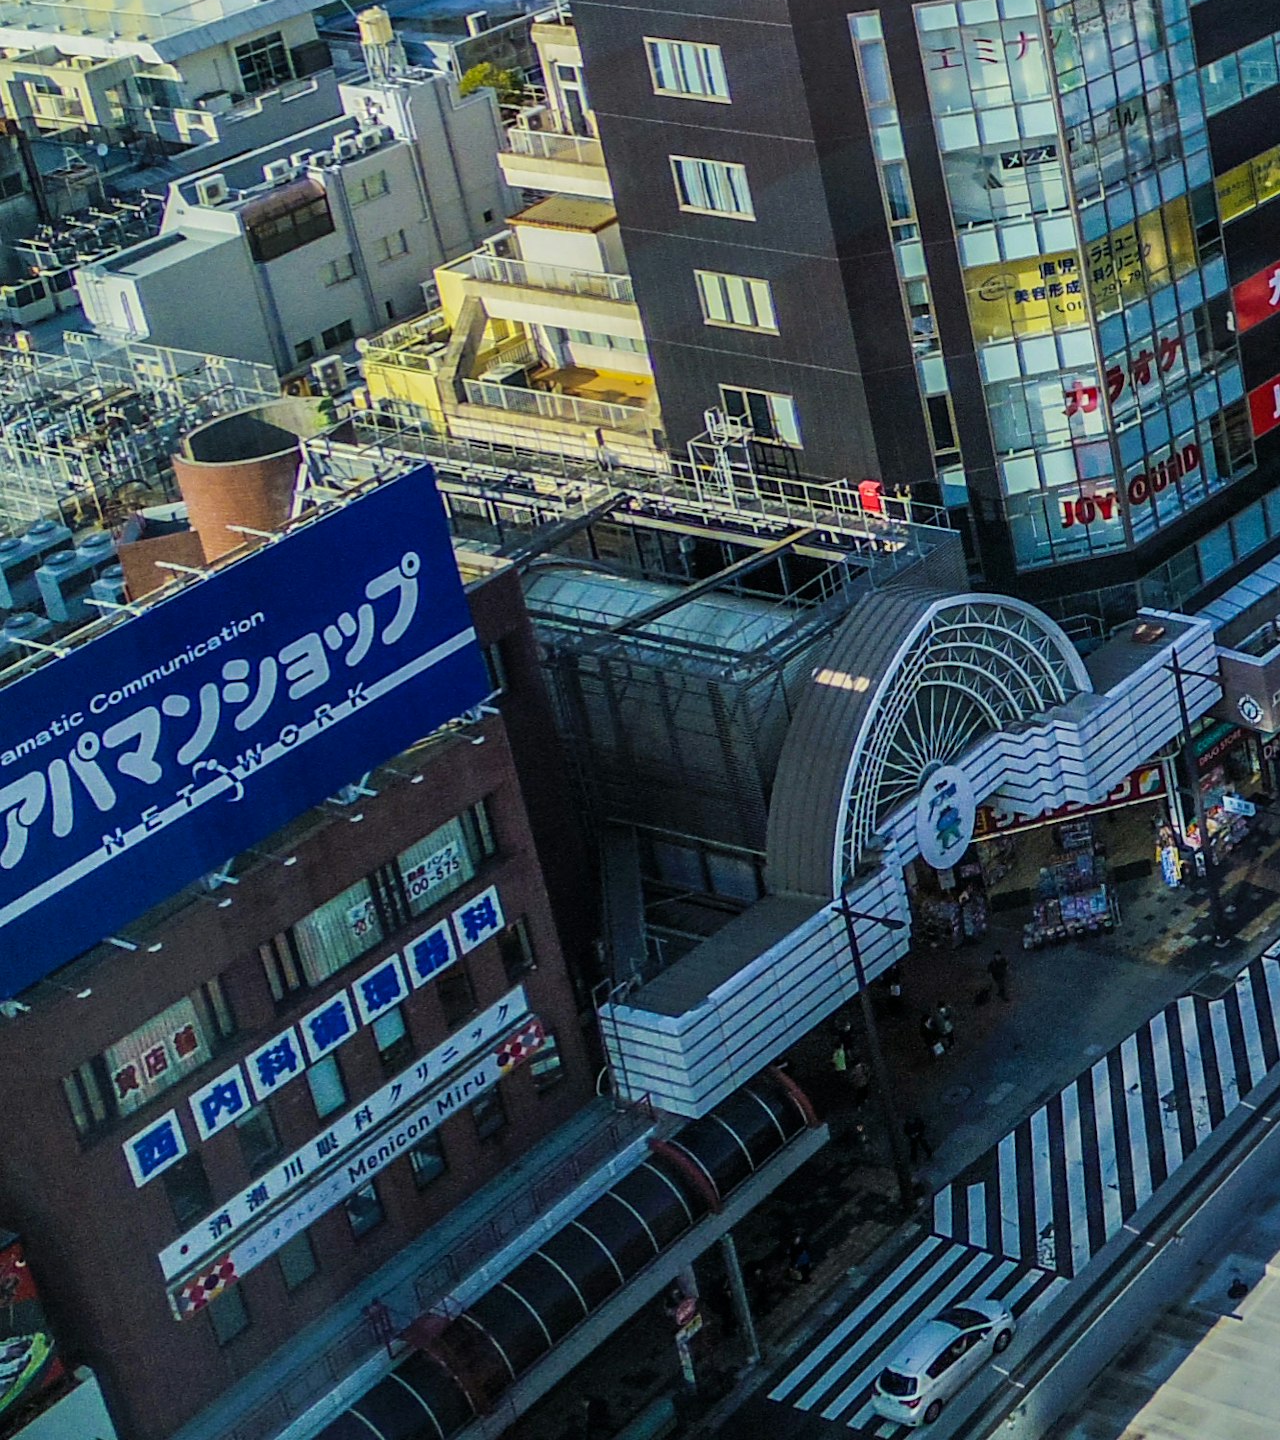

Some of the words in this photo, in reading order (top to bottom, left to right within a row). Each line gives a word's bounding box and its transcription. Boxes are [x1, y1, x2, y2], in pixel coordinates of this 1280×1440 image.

[1062, 336, 1184, 418] カラオケ
[1062, 443, 1200, 529] JOYOUND
[0, 550, 422, 870] アパマンショップ
[89, 609, 266, 715] Communication
[347, 1111, 432, 1186] Menicon
[435, 1069, 487, 1118] Miru
